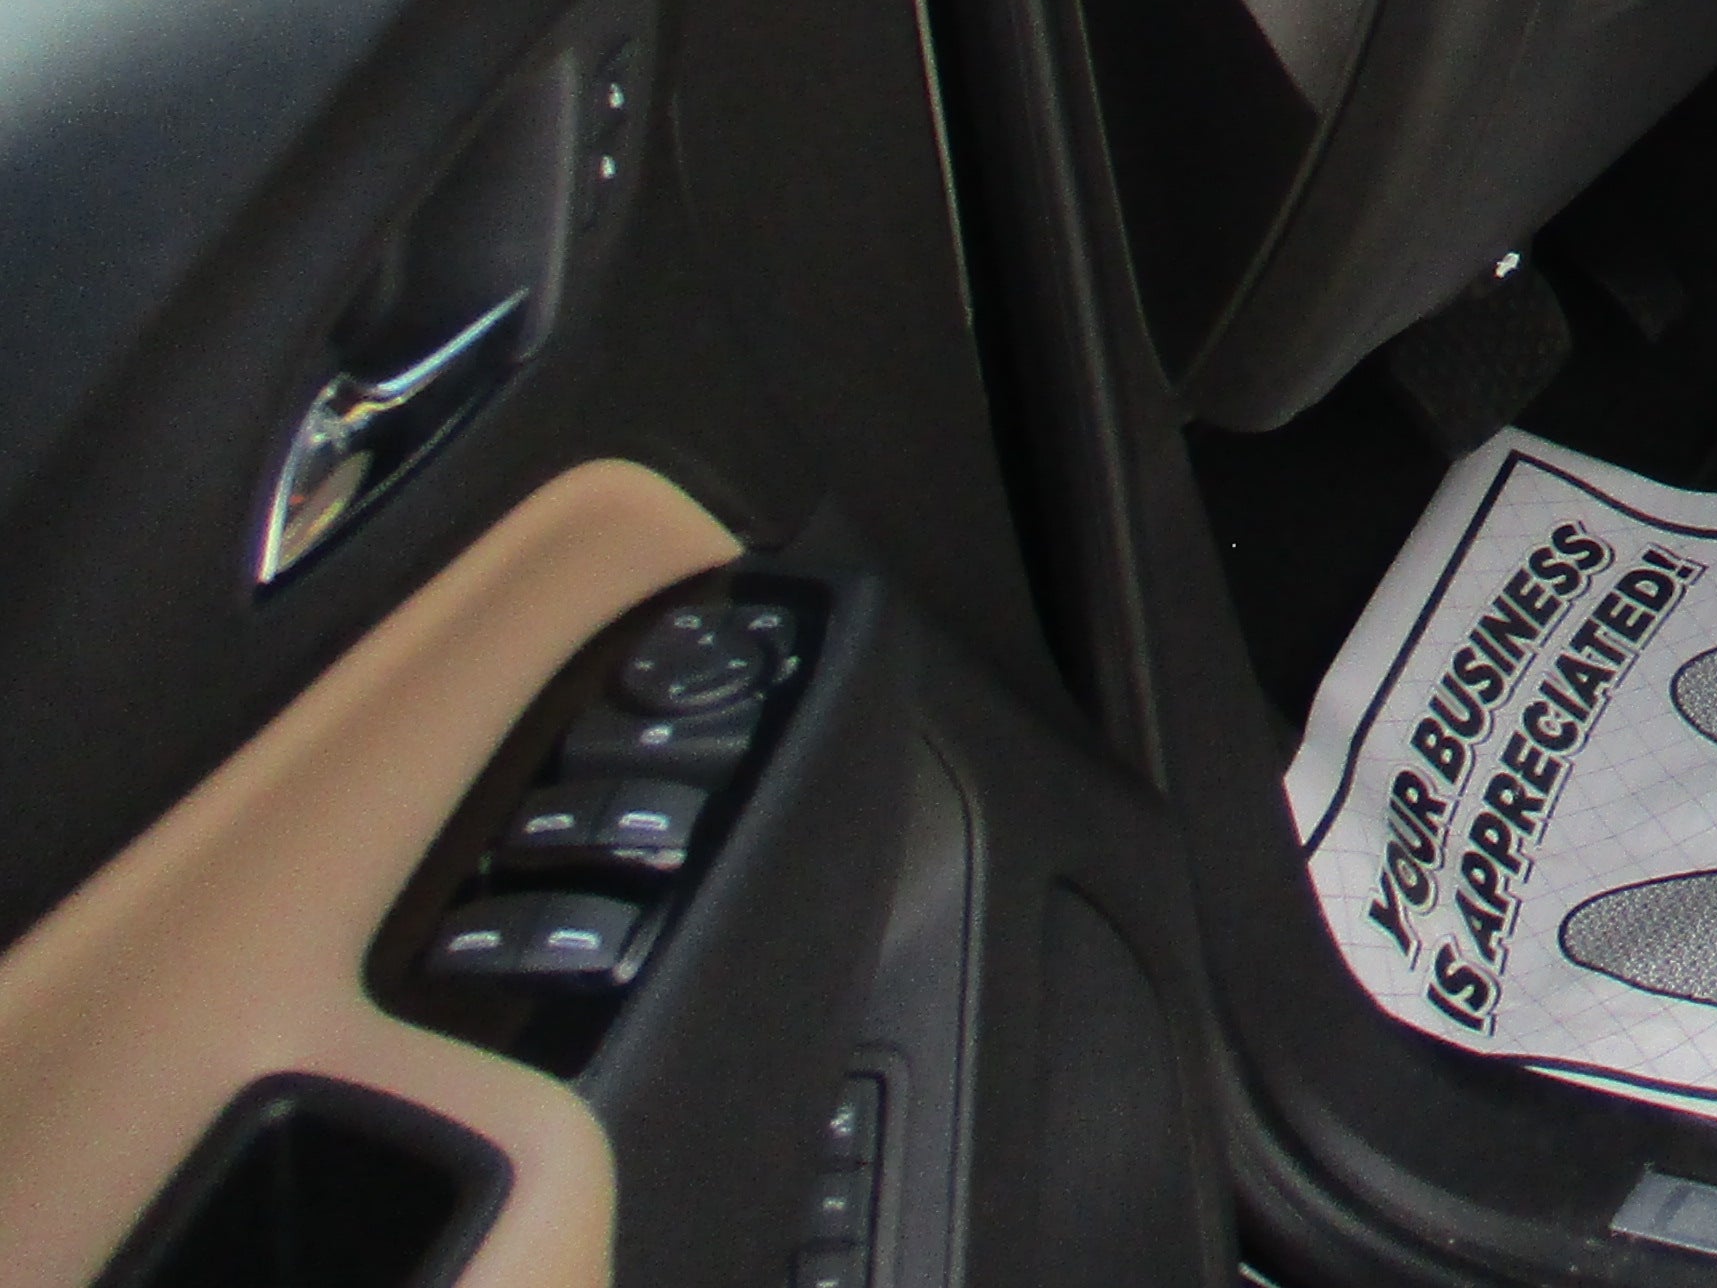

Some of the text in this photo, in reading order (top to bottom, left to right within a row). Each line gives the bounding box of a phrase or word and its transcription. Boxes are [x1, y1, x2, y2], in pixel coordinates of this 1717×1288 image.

[1366, 520, 1611, 962] YOUR BUSINESS
[1424, 545, 1704, 1035] IS APPRECIATED!
